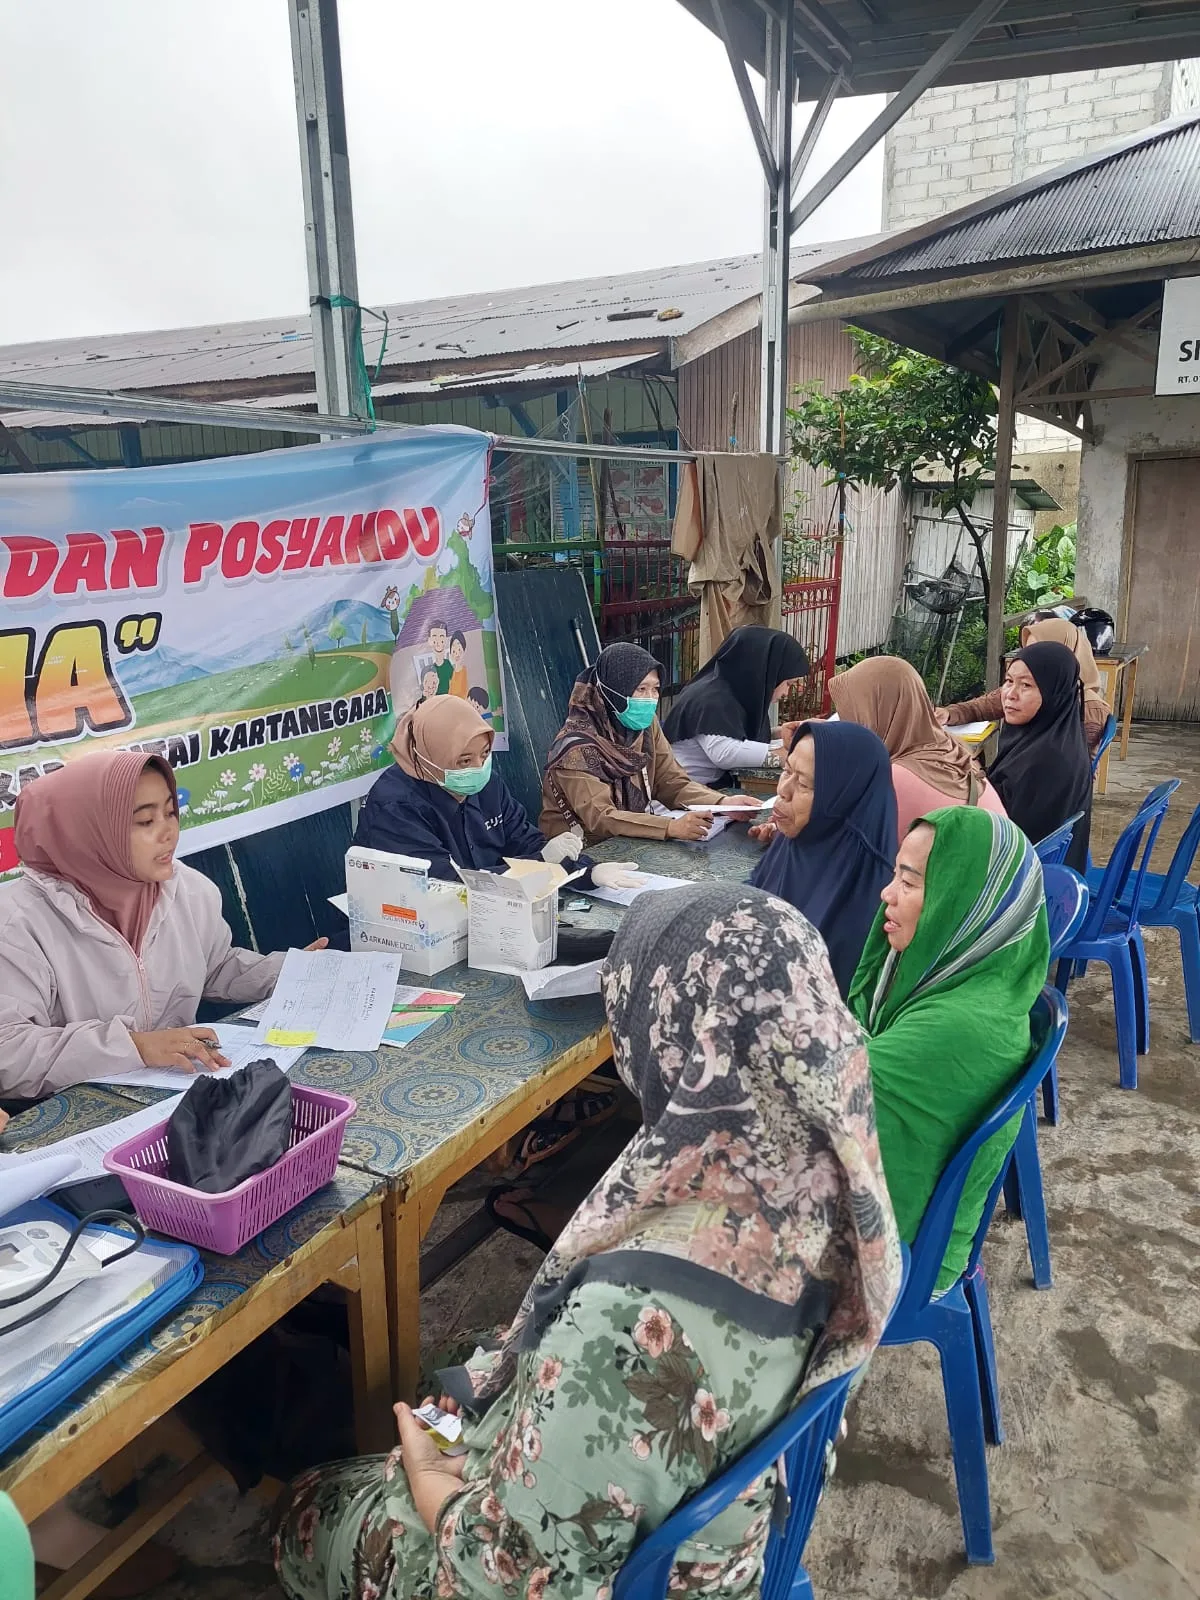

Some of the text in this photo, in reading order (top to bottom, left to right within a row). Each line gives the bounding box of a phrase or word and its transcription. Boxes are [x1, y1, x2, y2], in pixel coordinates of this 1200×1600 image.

[1178, 376, 1191, 384] RT.
[2, 506, 441, 599] DAN POSYANDU
[209, 688, 389, 758] KARTANEGARA
